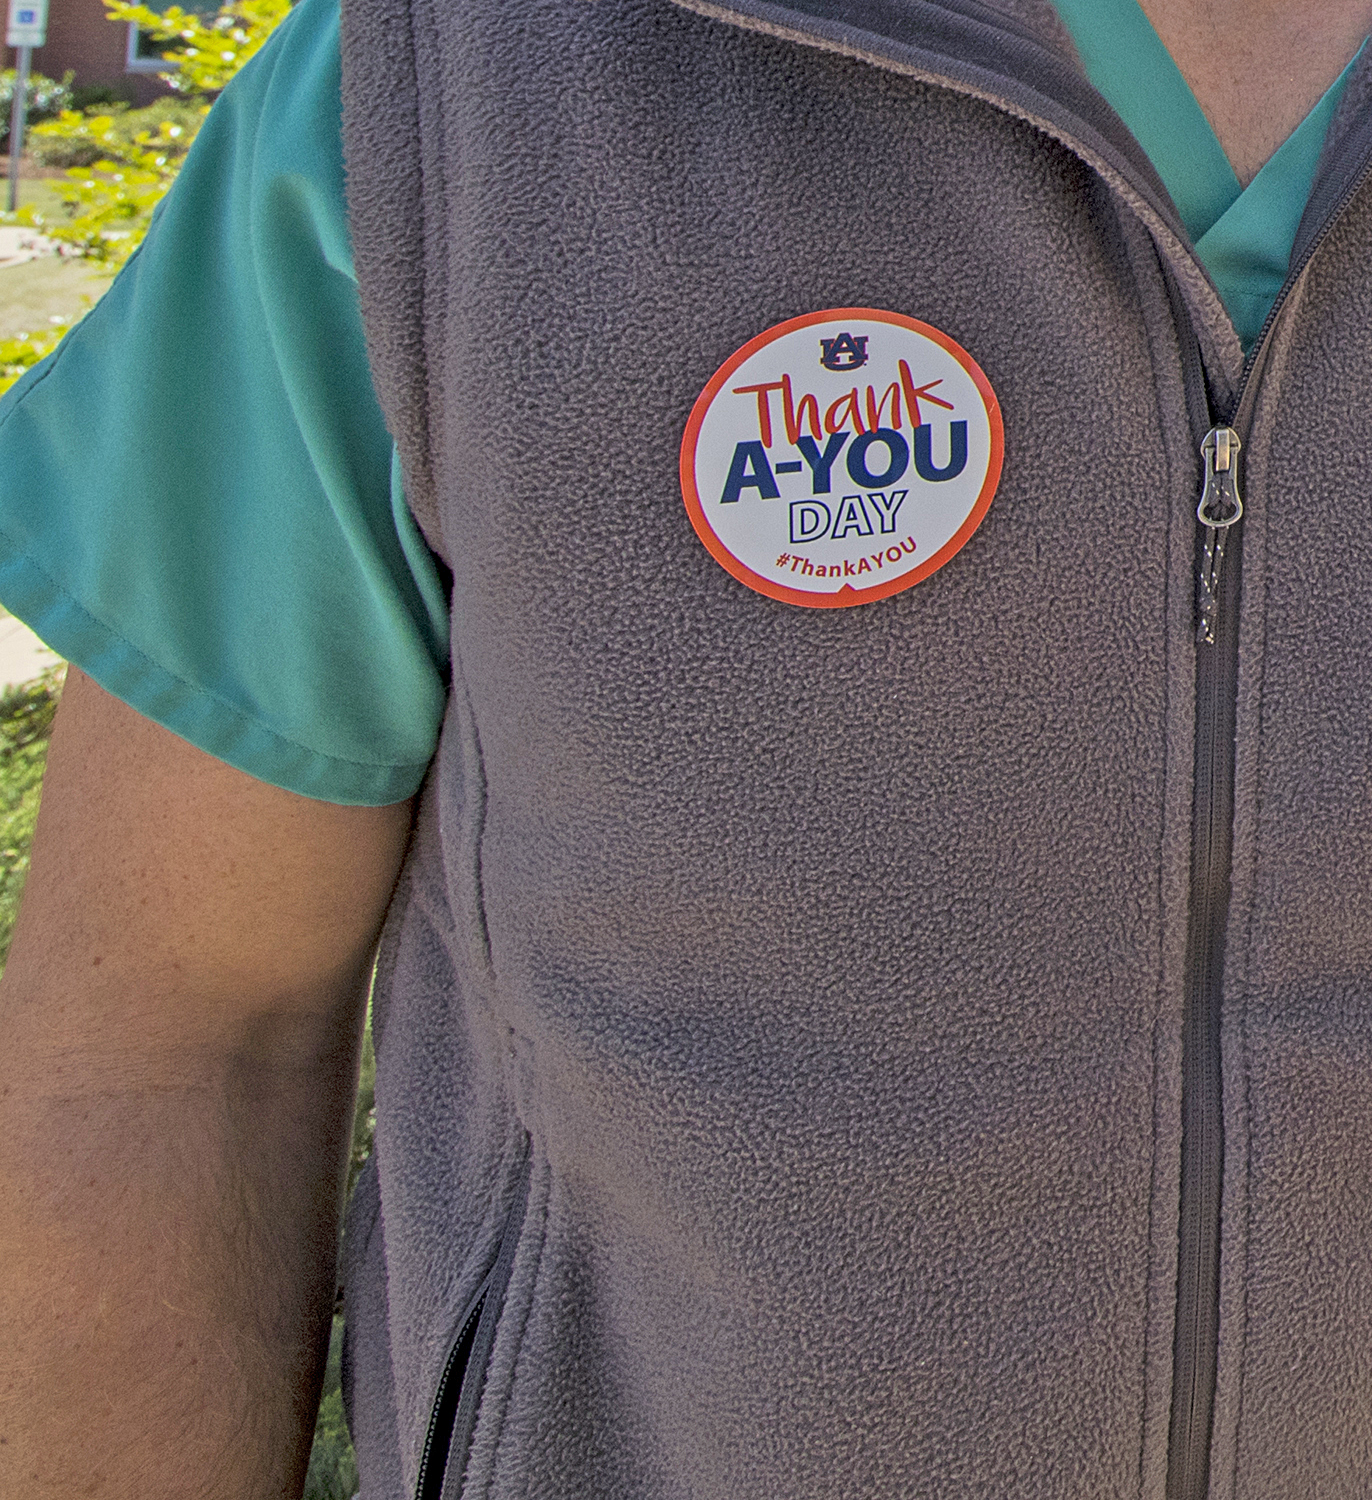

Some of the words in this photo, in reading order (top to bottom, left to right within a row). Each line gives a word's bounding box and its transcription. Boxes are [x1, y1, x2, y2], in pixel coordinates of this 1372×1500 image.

[732, 358, 955, 449] Thank
[719, 420, 969, 505] A-YOU
[788, 489, 909, 544] DAY
[775, 535, 917, 578] #ThankAYOU
